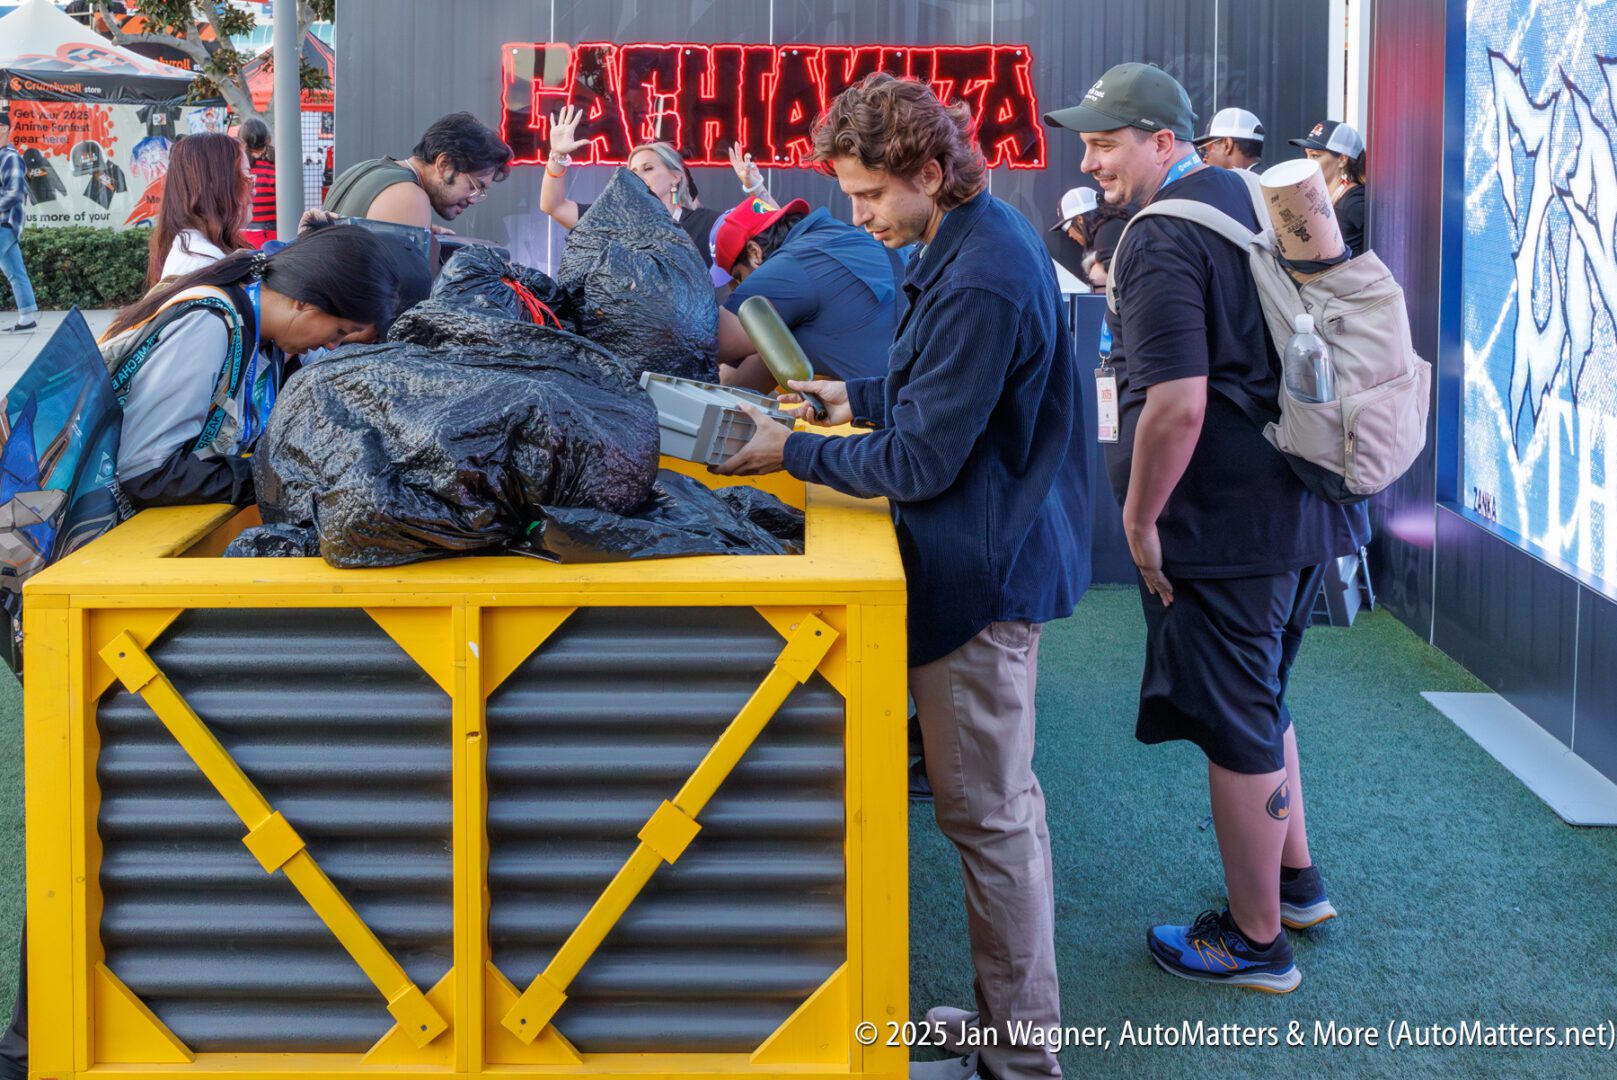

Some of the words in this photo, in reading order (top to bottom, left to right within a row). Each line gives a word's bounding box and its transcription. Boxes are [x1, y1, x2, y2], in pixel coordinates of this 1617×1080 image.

[24, 80, 81, 93] Crunchyroll
[500, 42, 1045, 167] GACHIATA
[14, 109, 34, 119] Get
[38, 111, 60, 121] your
[63, 110, 89, 120] 2025
[14, 121, 48, 131] Anime
[51, 122, 90, 132] Fanfest
[13, 136, 39, 145] gear
[42, 134, 70, 144] here!
[26, 214, 37, 222] us
[40, 214, 70, 222] more
[73, 211, 86, 221] of
[88, 213, 111, 223] your
[197, 415, 222, 449] BREAK
